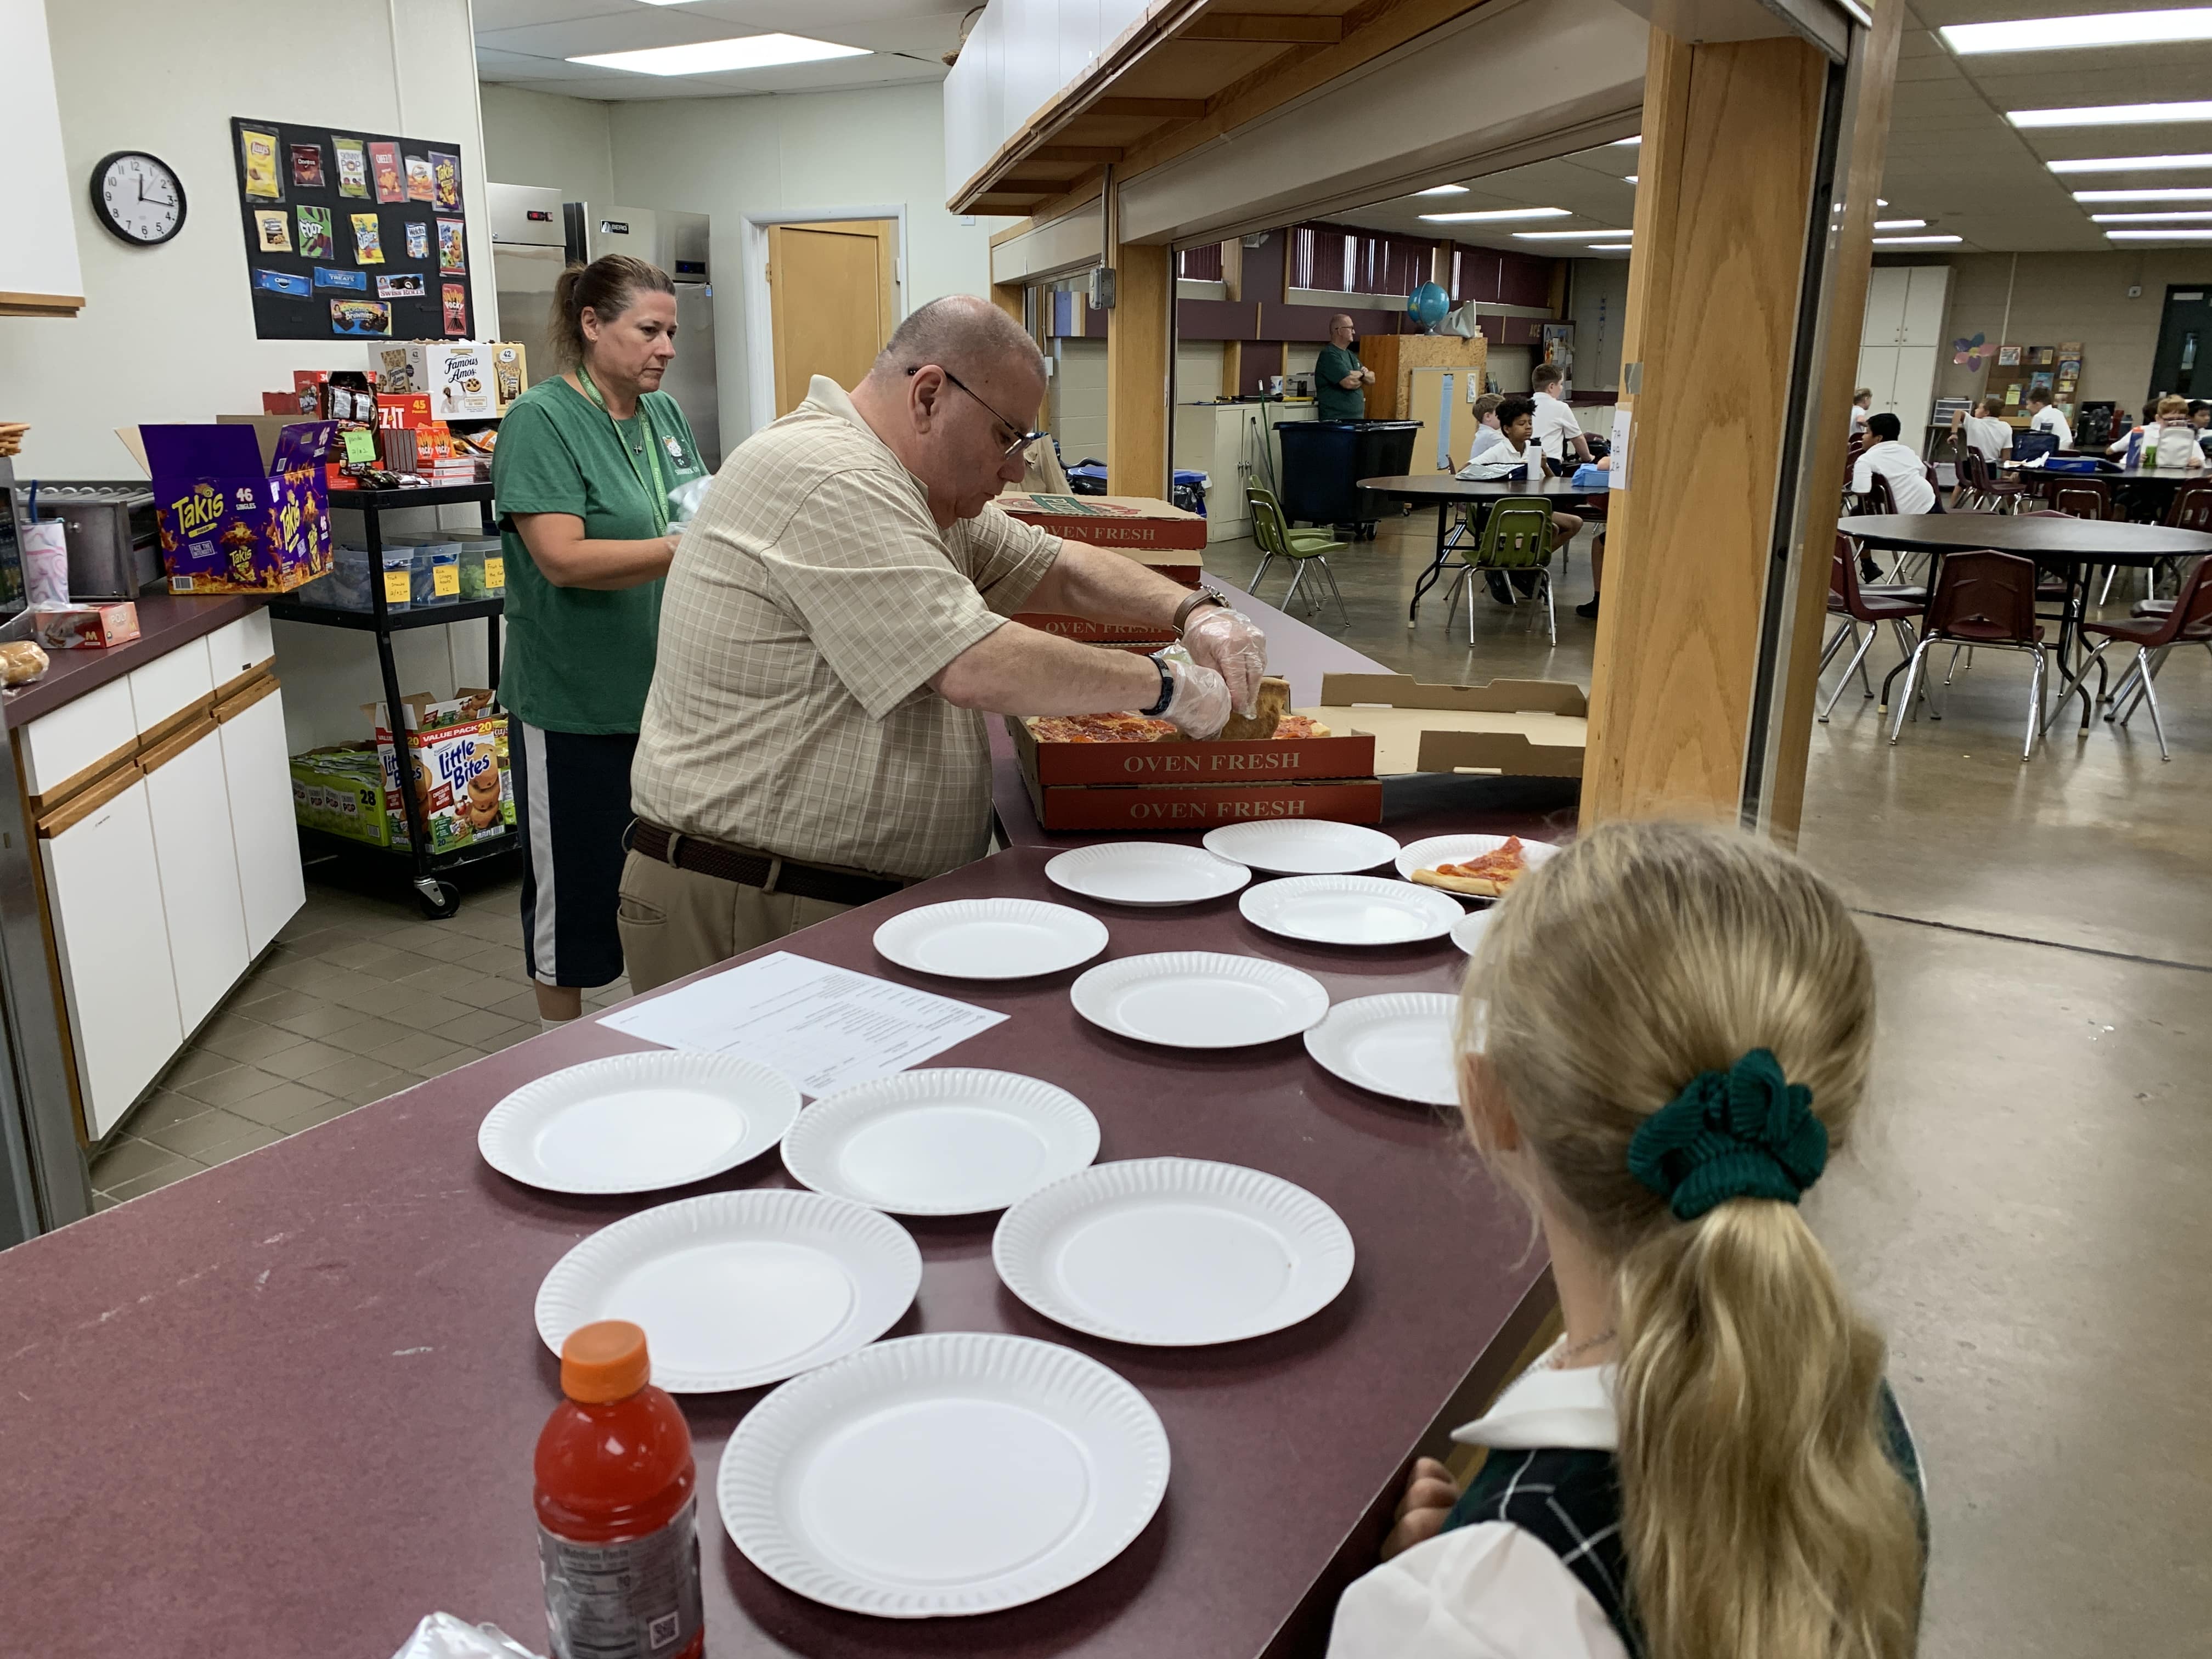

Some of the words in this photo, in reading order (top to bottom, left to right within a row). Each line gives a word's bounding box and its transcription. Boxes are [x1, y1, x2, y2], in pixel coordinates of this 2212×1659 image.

[118, 165, 124, 174] 11
[131, 161, 140, 171] 12
[436, 165, 454, 180] Takis
[108, 177, 117, 187] 10
[161, 179, 167, 189] 2
[105, 191, 111, 201] 9
[167, 195, 173, 205] 3
[113, 208, 119, 218] 8
[165, 212, 171, 221] 4
[126, 221, 131, 229] 7
[142, 225, 148, 235] 6
[156, 222, 162, 232] 5
[300, 220, 324, 238] FOOT
[444, 357, 478, 374] Famous
[448, 368, 476, 383] Amos
[413, 400, 426, 409] 45
[643, 422, 652, 441] School
[236, 488, 253, 501] 46
[172, 493, 224, 534] Takis
[280, 499, 301, 551] Takis
[1094, 527, 1155, 540] FRESH
[229, 549, 252, 566] Takis
[111, 612, 127, 624] POLY
[1045, 622, 1096, 634] OVEN
[85, 631, 98, 641] M
[478, 721, 492, 733] 20
[422, 731, 453, 743] VALUE
[454, 724, 478, 736] PACK
[407, 736, 419, 746] 20
[439, 740, 475, 780] Little
[1124, 755, 1200, 772] OVEN
[1211, 752, 1301, 770] FRESH
[453, 754, 490, 790] Bites
[360, 789, 376, 806] 28
[343, 803, 356, 812] POP
[1130, 803, 1206, 819] OVEN
[1216, 800, 1307, 817] FRESH
